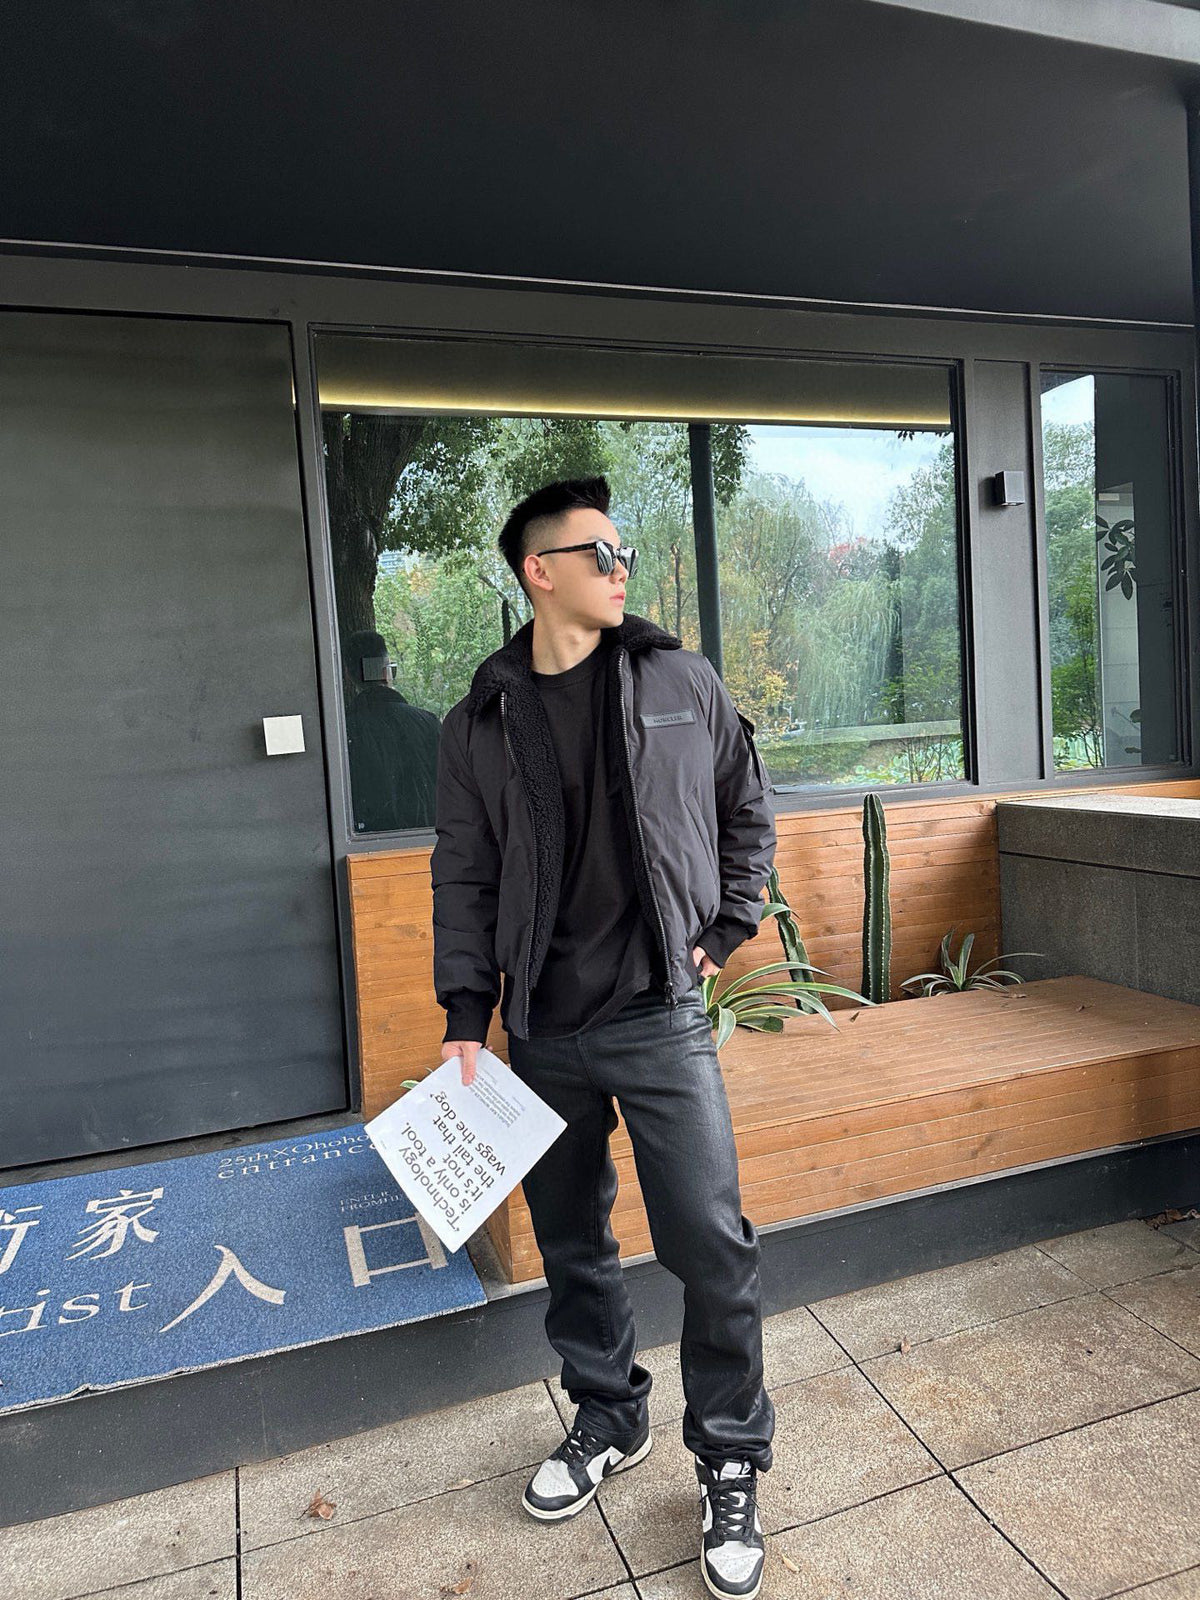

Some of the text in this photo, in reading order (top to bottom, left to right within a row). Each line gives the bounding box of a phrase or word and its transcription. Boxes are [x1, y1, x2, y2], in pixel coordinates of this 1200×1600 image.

[455, 1120, 477, 1144] the
[401, 1122, 473, 1215] is only a tool.
[432, 1115, 496, 1188] the tail that
[442, 1154, 466, 1179] not
[474, 1142, 507, 1176] wags
